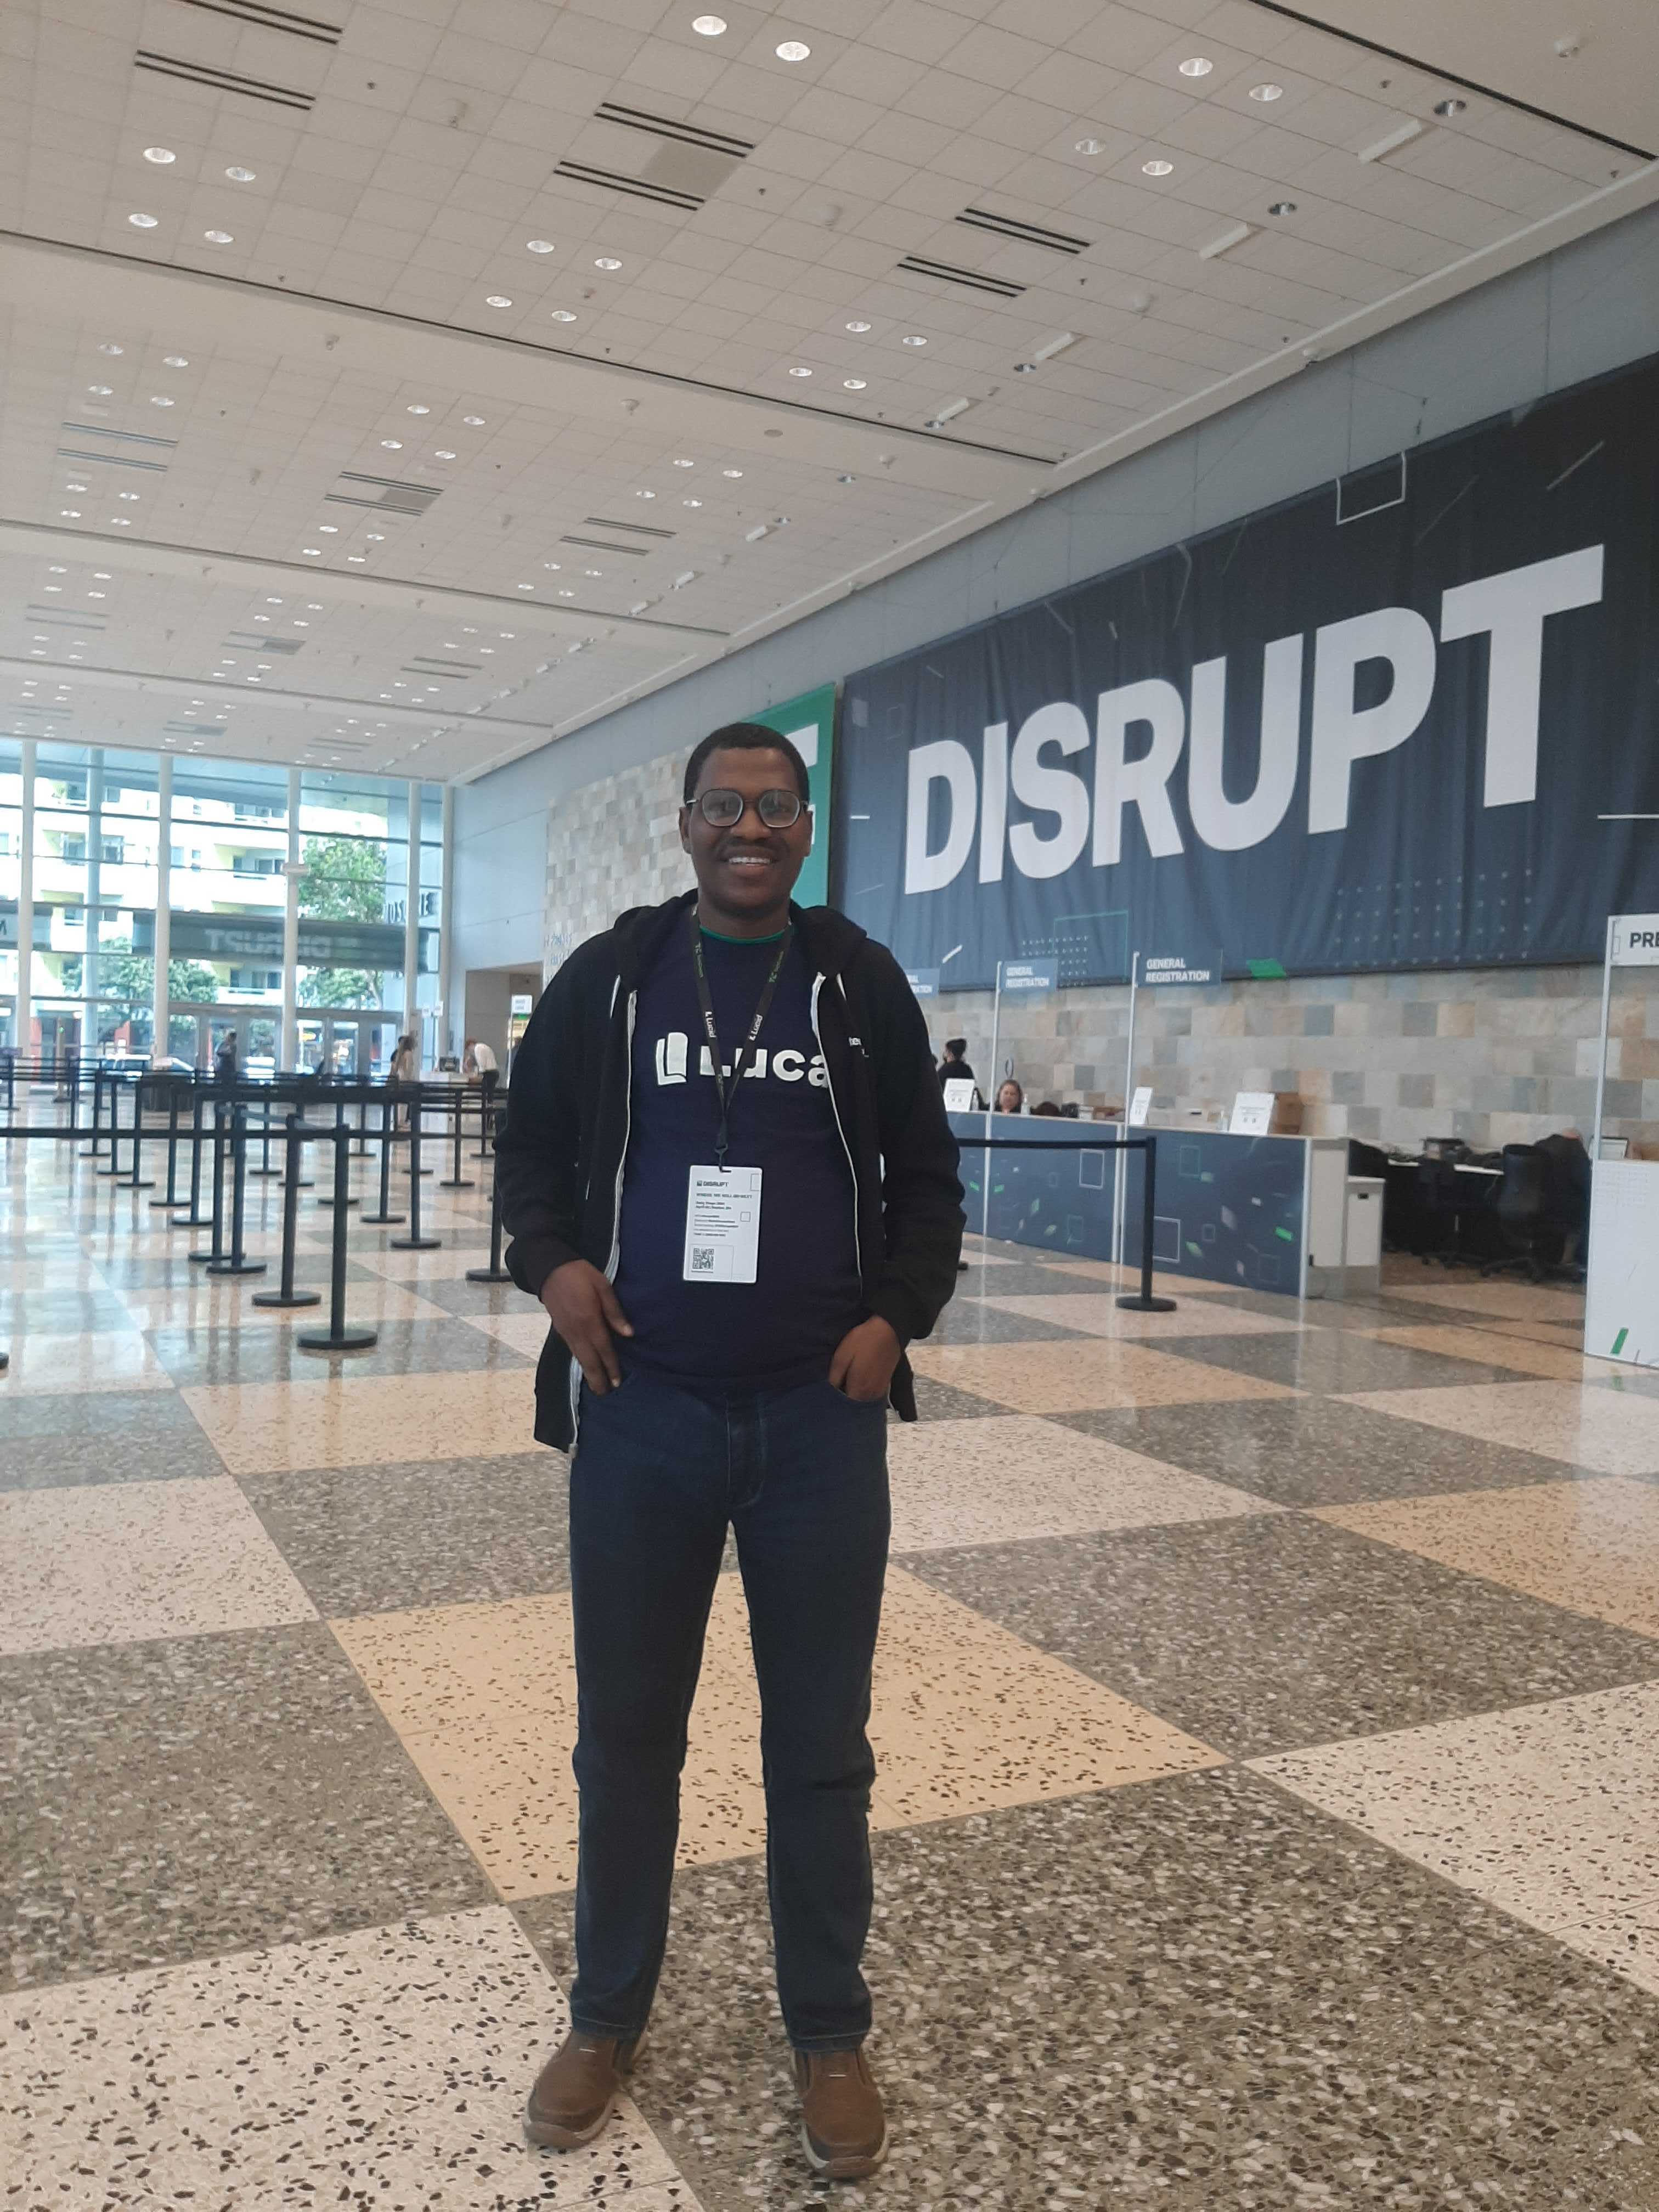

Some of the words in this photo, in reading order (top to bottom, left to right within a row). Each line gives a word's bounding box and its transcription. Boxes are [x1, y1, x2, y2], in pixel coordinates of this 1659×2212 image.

[905, 543, 1604, 895] DISRUPT
[1146, 957, 1186, 970] GENERAL
[1145, 969, 1210, 983] REGISTRATION
